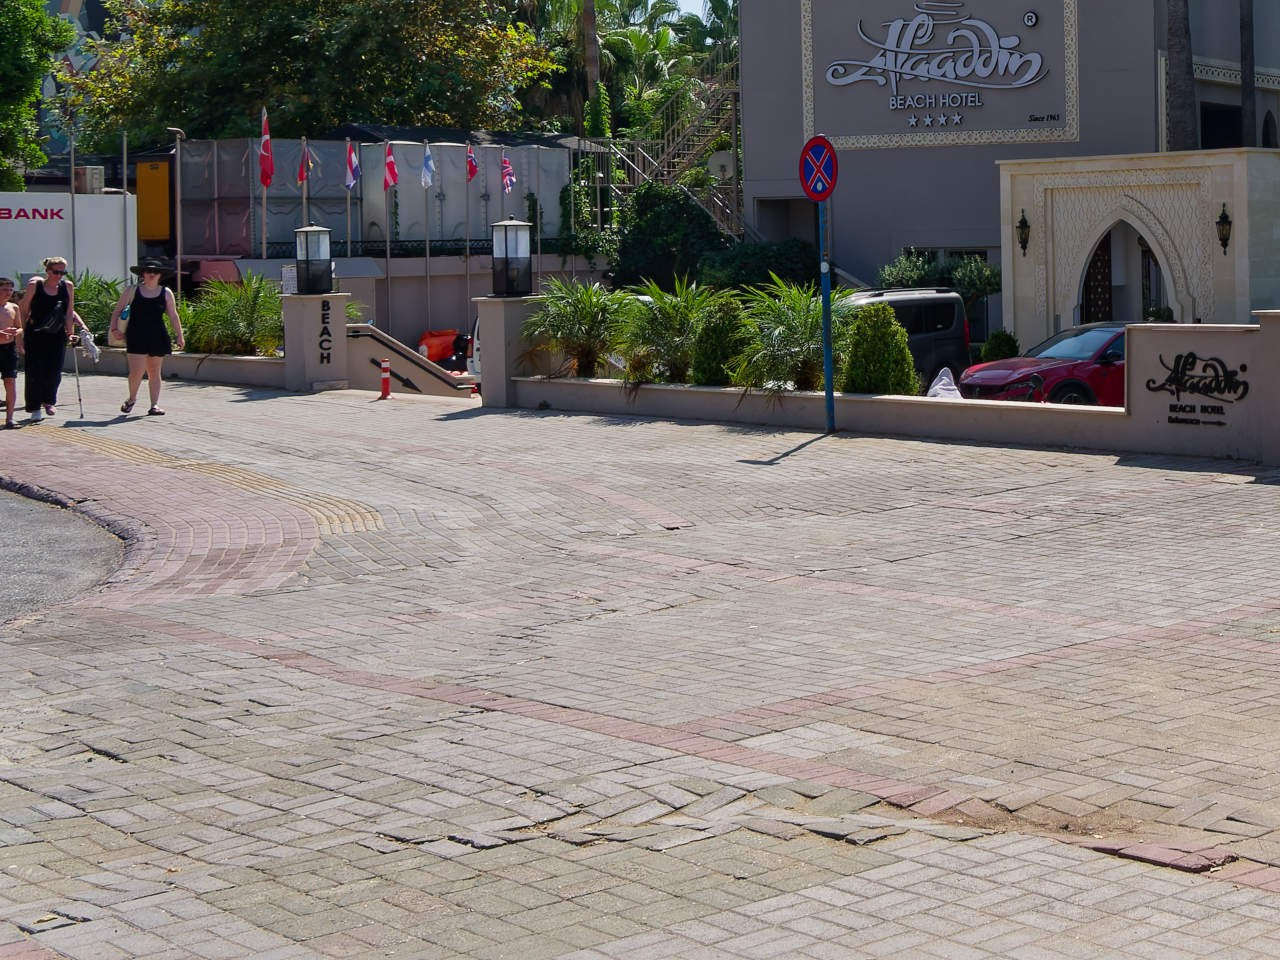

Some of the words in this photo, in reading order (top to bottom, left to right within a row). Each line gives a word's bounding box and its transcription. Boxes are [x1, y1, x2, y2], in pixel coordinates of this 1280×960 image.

[825, 13, 1049, 96] Aladdin
[889, 95, 936, 110] BEACH
[940, 92, 983, 107] HOTEL
[319, 300, 333, 365] BEACH
[1169, 404, 1196, 414] BEACH
